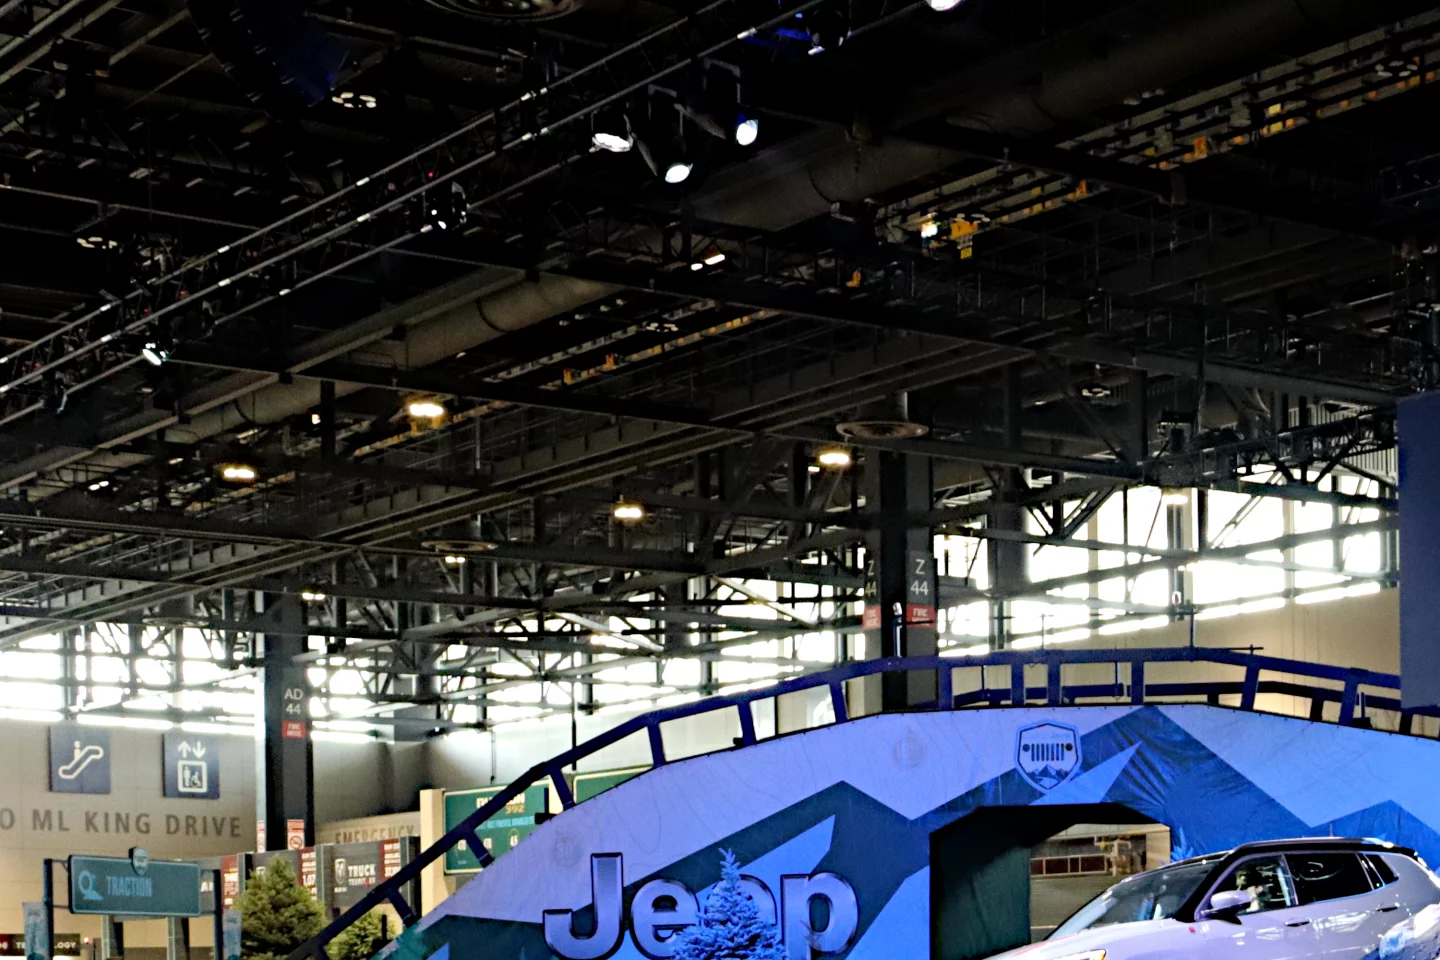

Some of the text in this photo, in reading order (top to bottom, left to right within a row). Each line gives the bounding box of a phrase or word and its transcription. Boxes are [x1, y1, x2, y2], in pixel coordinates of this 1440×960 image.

[915, 559, 925, 575] Z
[865, 581, 877, 598] 44
[910, 580, 929, 596] 44
[284, 687, 304, 700] AD
[285, 703, 301, 715] 44
[505, 803, 525, 815] 392
[32, 809, 70, 831] ML
[85, 811, 151, 834] KING
[165, 814, 242, 837] DRIVE
[348, 864, 376, 877] TRUCK
[106, 876, 153, 898] TRACTION
